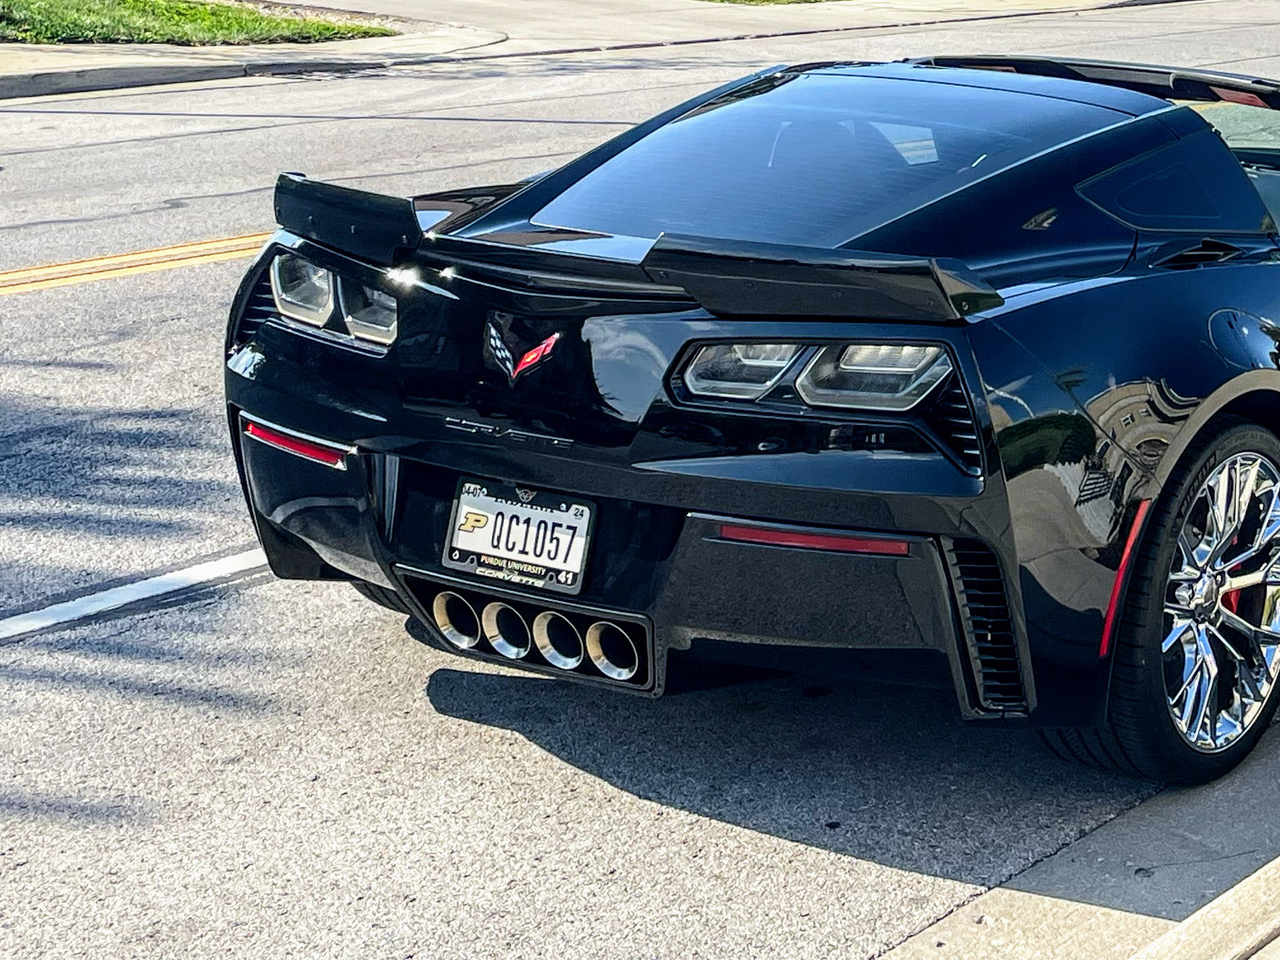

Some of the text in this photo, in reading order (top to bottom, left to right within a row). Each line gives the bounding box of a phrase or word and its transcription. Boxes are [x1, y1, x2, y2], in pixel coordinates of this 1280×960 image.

[573, 507, 584, 518] 24
[491, 511, 578, 564] QC1057
[480, 554, 547, 576] PURDUE UNIVERSITY
[558, 570, 574, 585] 41
